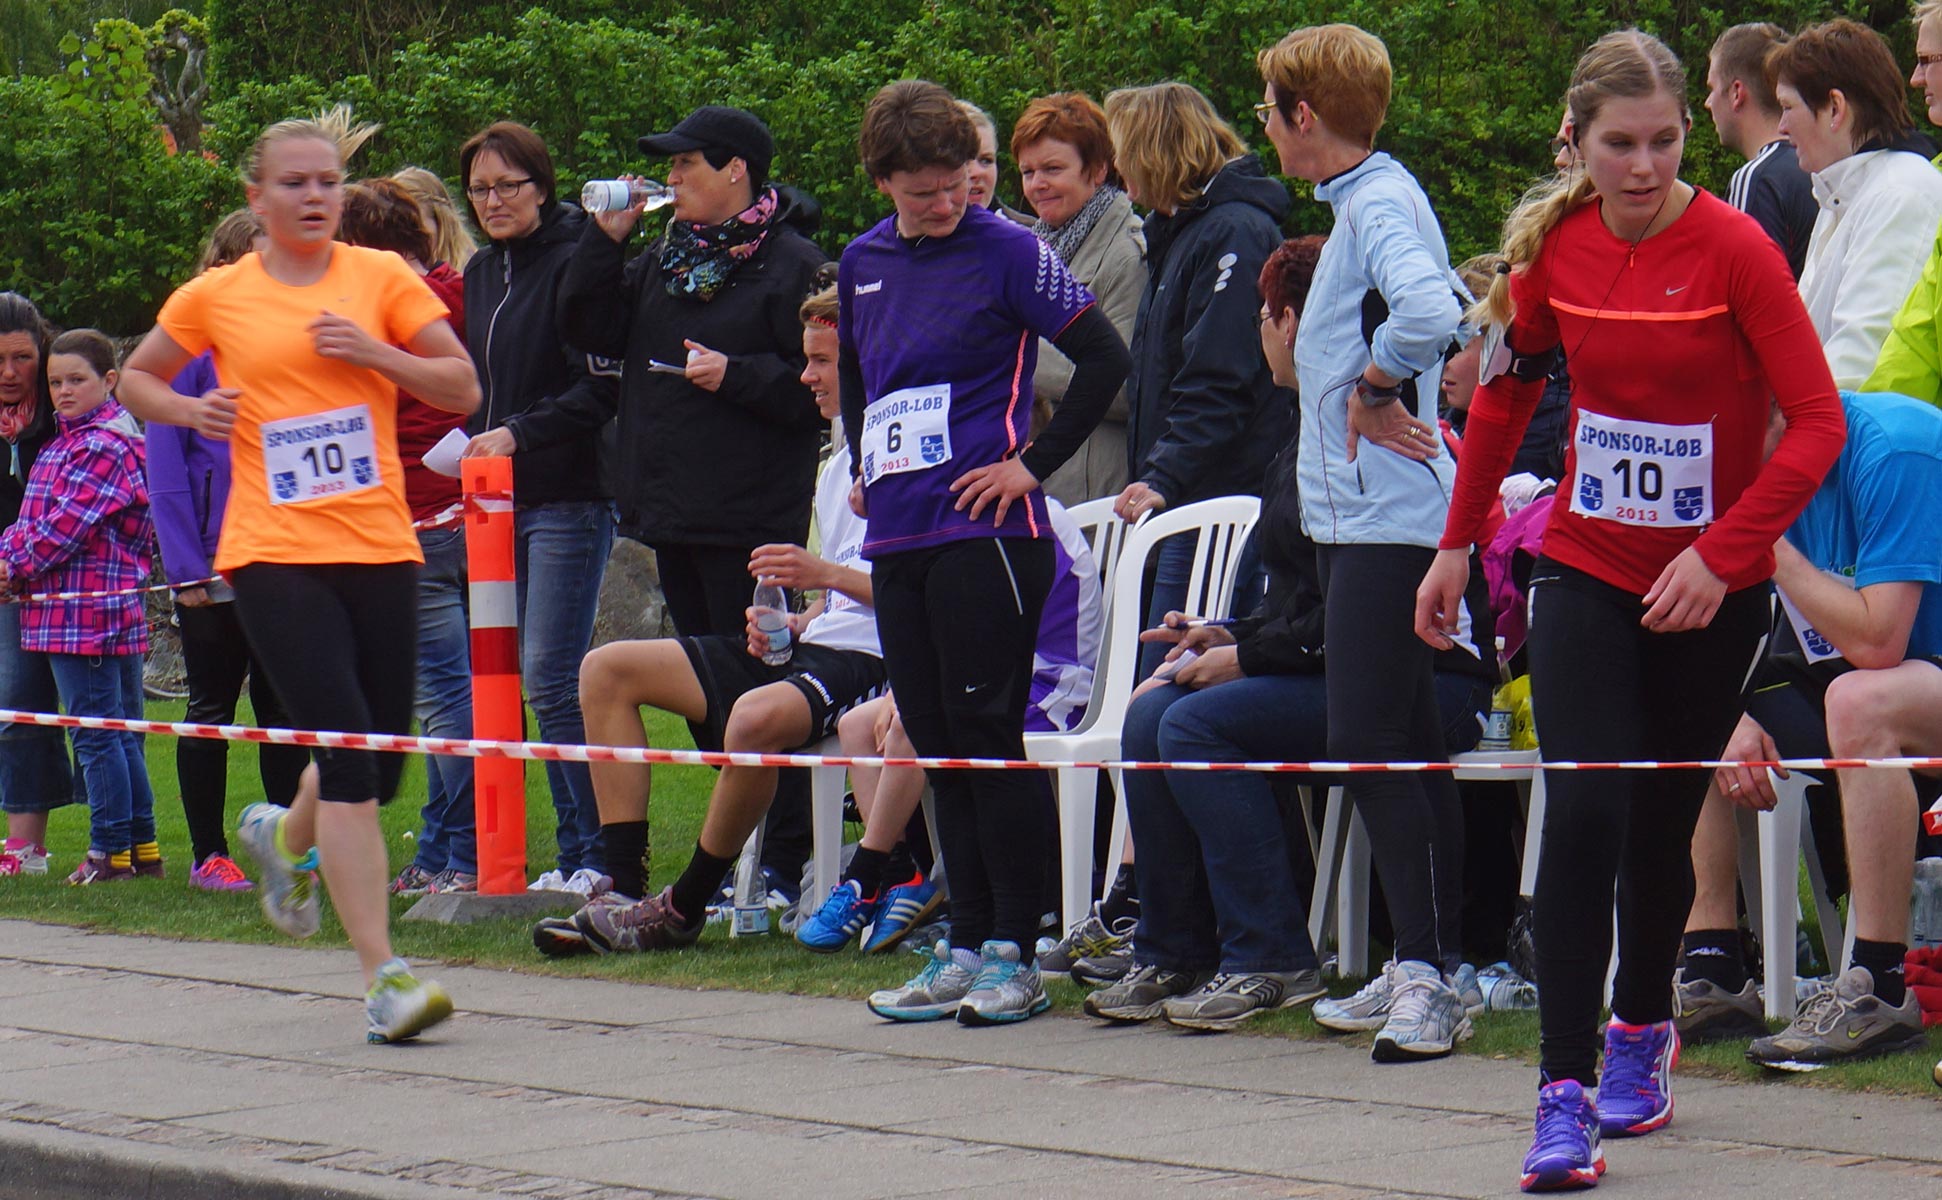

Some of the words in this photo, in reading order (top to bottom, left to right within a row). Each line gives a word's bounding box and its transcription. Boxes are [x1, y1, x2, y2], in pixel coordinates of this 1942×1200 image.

[854, 279, 882, 296] hummel
[865, 396, 943, 432] SPONSOR-LØB
[887, 421, 902, 454] 6
[1580, 424, 1702, 457] SPONSOR-LØB
[302, 443, 343, 477] 10
[881, 457, 910, 473] 2013
[310, 481, 346, 495] 2013
[1612, 458, 1662, 502] 10
[1616, 506, 1659, 522] 2013
[800, 672, 834, 706] hummel
